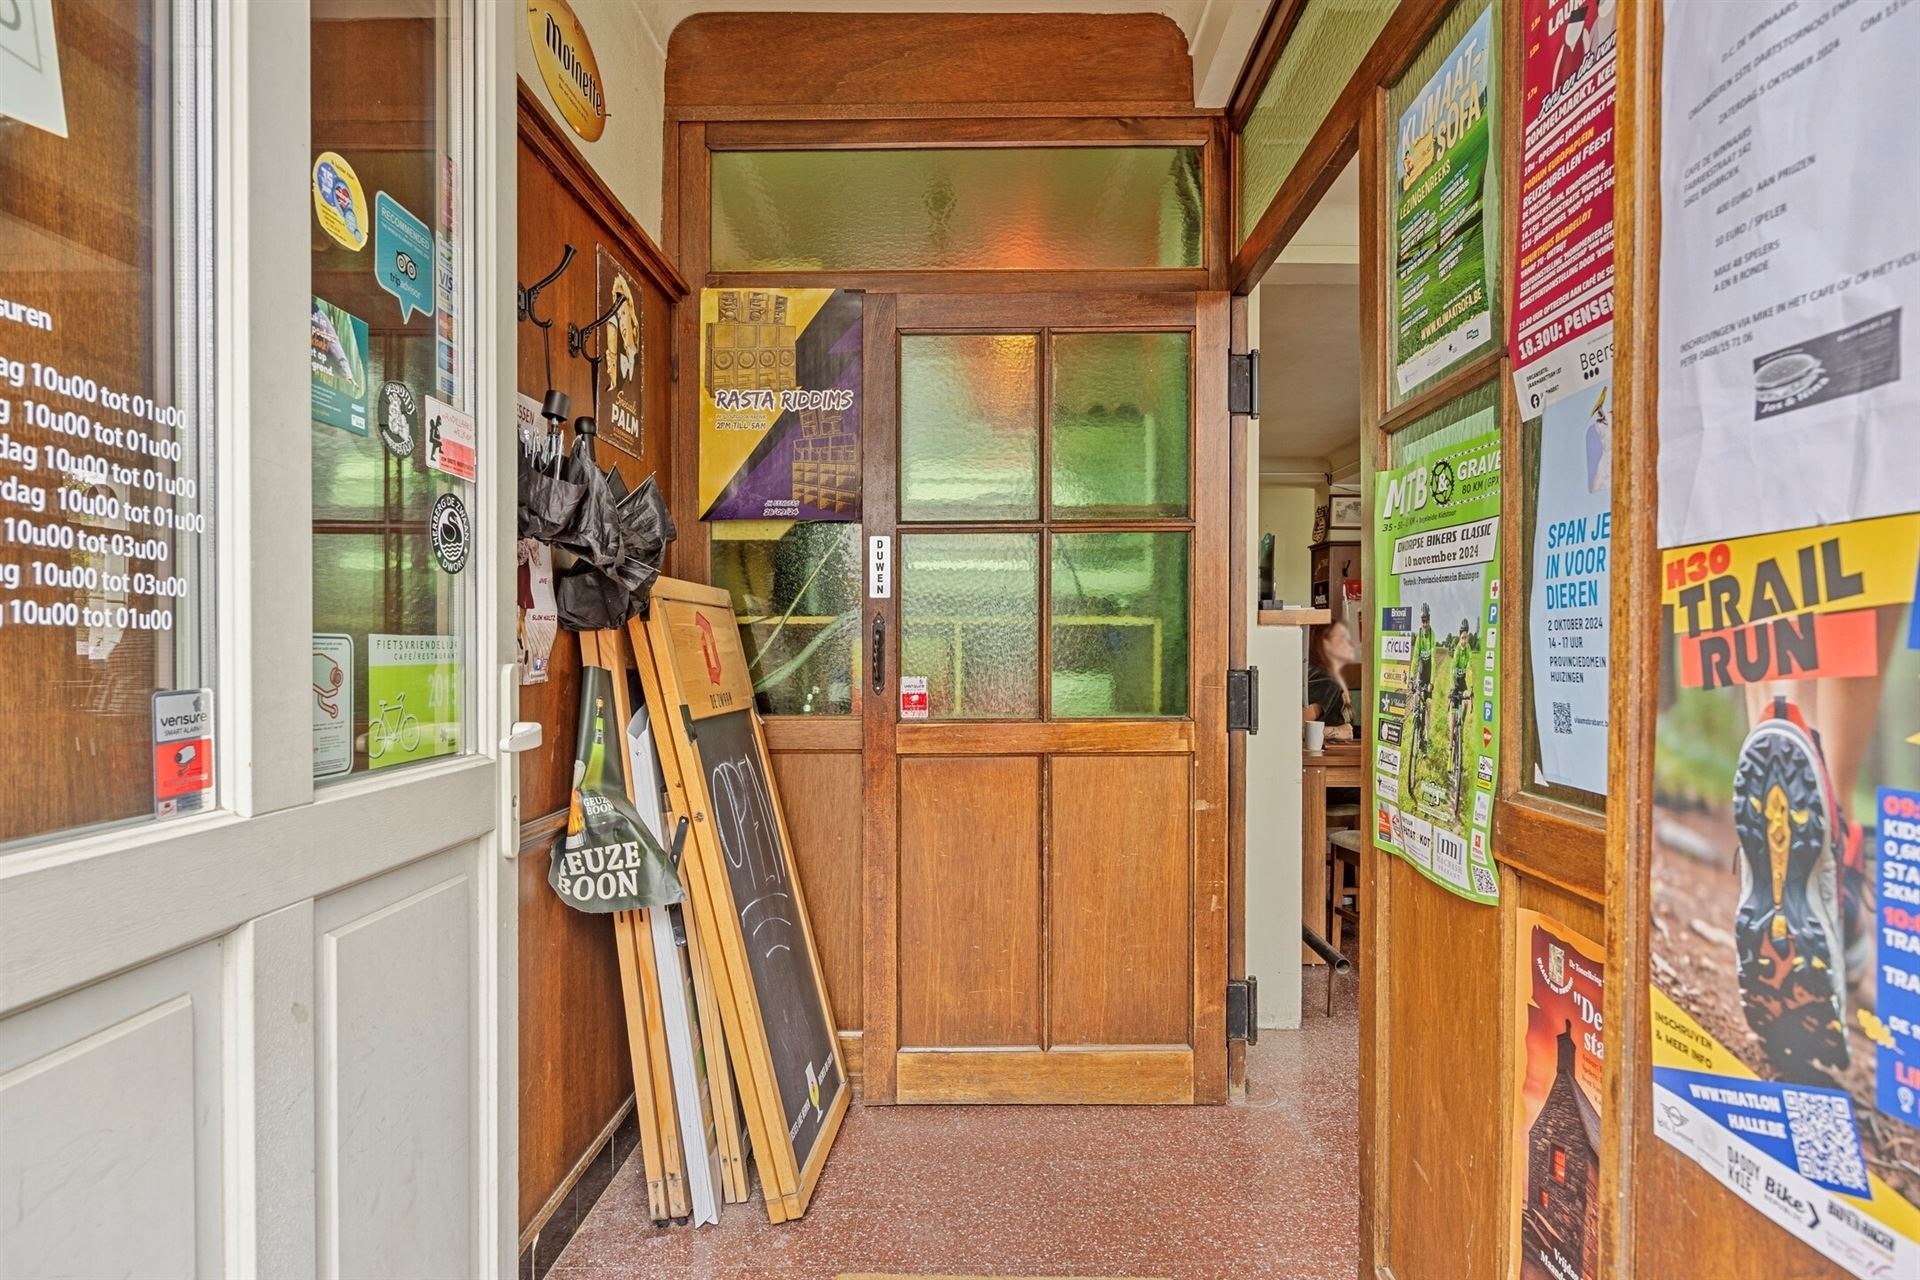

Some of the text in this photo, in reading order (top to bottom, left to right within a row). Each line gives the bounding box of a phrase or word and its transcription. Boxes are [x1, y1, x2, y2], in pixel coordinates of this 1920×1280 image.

[1748, 1, 1799, 40] WINNAARS
[1752, 13, 1830, 69] DARTSTORNOOI
[544, 11, 603, 117] Moinette
[1718, 90, 1758, 125] ZATERDAG
[1766, 55, 1815, 91] OKTOBER
[1815, 37, 1841, 62] 2024
[1859, 11, 1882, 33] OM
[1402, 37, 1483, 151] KLIMAAT-
[1436, 79, 1481, 162] SOFA
[1525, 79, 1596, 150] ROMMELMARKT,
[1547, 127, 1595, 173] EUROPAPLEIN
[1701, 154, 1712, 168] DE
[1712, 125, 1753, 161] WINNAARS
[1523, 151, 1582, 210] REUZENBELLEN
[1582, 127, 1613, 161] FEEST
[1730, 187, 1754, 208] EURO
[1755, 174, 1776, 193] AAN
[1777, 154, 1817, 182] PRIJZEN
[381, 206, 430, 250] RECOMMENDED
[1724, 222, 1748, 243] EURO
[1753, 203, 1788, 228] SPELER
[1712, 283, 1720, 294] A
[1719, 277, 1731, 289] EN
[1739, 260, 1770, 282] RONDE
[1713, 261, 1732, 278] MAX
[1743, 238, 1781, 264] SPELERS
[389, 272, 423, 300] tripadvisor
[1736, 316, 1751, 330] VIA
[1751, 306, 1775, 325] MIKE
[1775, 302, 1786, 314] IN
[1786, 293, 1808, 310] HET
[1808, 281, 1836, 302] CAFE
[1836, 276, 1853, 293] OF
[1854, 269, 1872, 286] OP
[1871, 259, 1895, 280] HET
[1420, 287, 1482, 341] WWW.KLIMAATSOFA.BE
[1518, 321, 1564, 361] 18.30U:
[1679, 353, 1699, 369] PETER
[31, 362, 187, 429] 10u00 tot 01u00
[714, 389, 854, 412] RASTA RIDDIMS
[1760, 400, 1783, 414] Jos
[1784, 394, 1797, 408] &
[23, 400, 181, 462] 10u00 tot 01u00
[610, 404, 639, 438] PALM
[716, 421, 767, 431] 2PM TILL 5AM
[44, 445, 196, 498] 10u00 tot 01u00
[1461, 481, 1484, 495] 80 KM
[57, 487, 206, 533] 10u00 tot 01u00
[1383, 467, 1428, 520] MTB
[3, 517, 168, 561] 10u00 tot 03u00
[431, 498, 447, 547] HERBERG
[1426, 529, 1458, 547] BIKERS
[1461, 522, 1493, 542] CLASSIC
[1548, 511, 1612, 550] SPAN JE
[442, 556, 466, 571] DWORP
[875, 539, 885, 595] DUWEN
[1413, 549, 1457, 567] november
[1459, 543, 1480, 561] 2024
[1545, 545, 1607, 580] IN VOOR
[1666, 542, 1731, 591] H30
[31, 561, 187, 597] 10u00 tot 03u00
[1545, 579, 1599, 610] DIEREN
[1679, 537, 1865, 639] TRAIL
[10, 599, 173, 631] 10u00 tot 01u00
[1547, 616, 1604, 632] 2 OKTOBER 2024
[1549, 655, 1607, 669] PROVINCIEDOMEIN
[1561, 636, 1569, 649] 17
[1569, 635, 1584, 649] UUR
[1699, 611, 1820, 691] RUN
[1550, 671, 1585, 684] HUIZINGEN
[585, 803, 615, 817] BOON
[557, 871, 639, 902] BOON
[1655, 1011, 1713, 1051] INSCHRIJVEN
[1665, 1036, 1690, 1058] MEER
[1690, 1049, 1713, 1069] INFO
[1764, 1176, 1806, 1215] Bike
